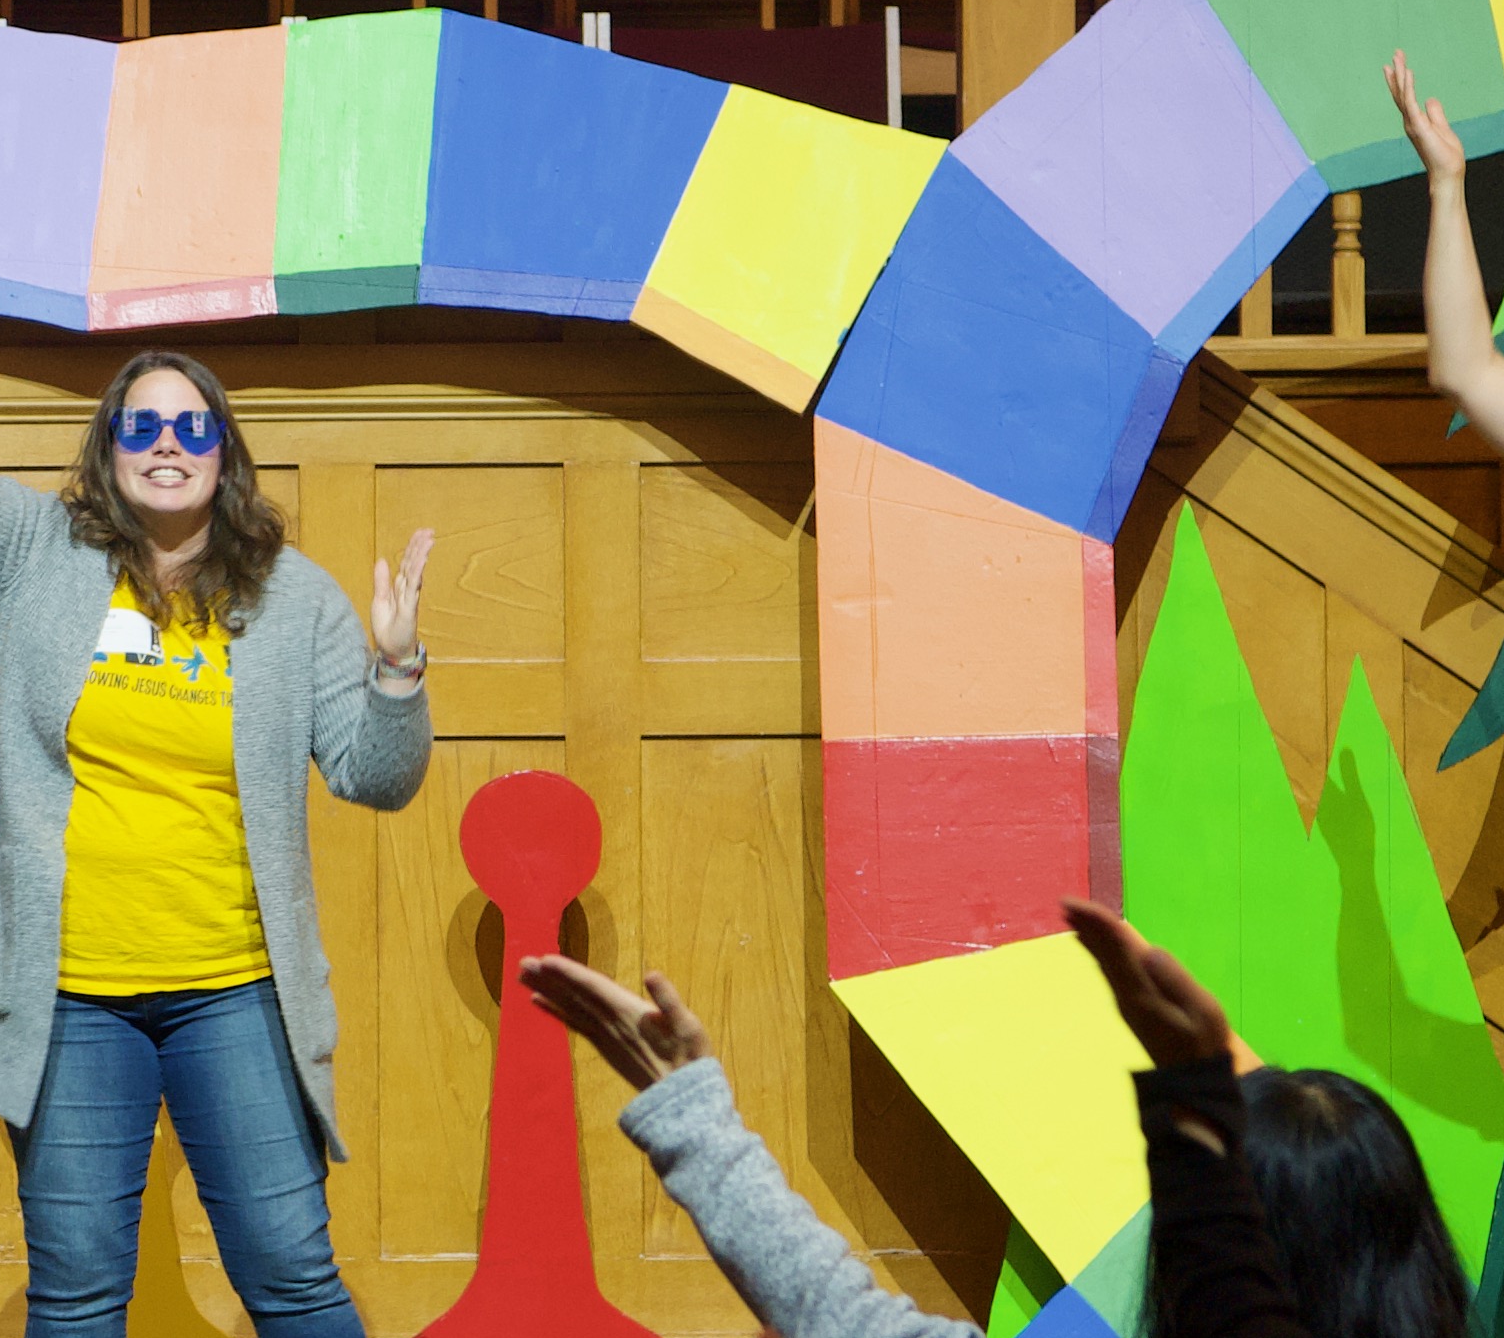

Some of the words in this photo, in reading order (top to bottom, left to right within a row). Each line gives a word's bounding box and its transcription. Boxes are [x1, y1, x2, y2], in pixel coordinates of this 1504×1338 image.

[84, 670, 129, 690] OWING
[131, 678, 166, 698] JESUS
[169, 684, 217, 706] CHANGES
